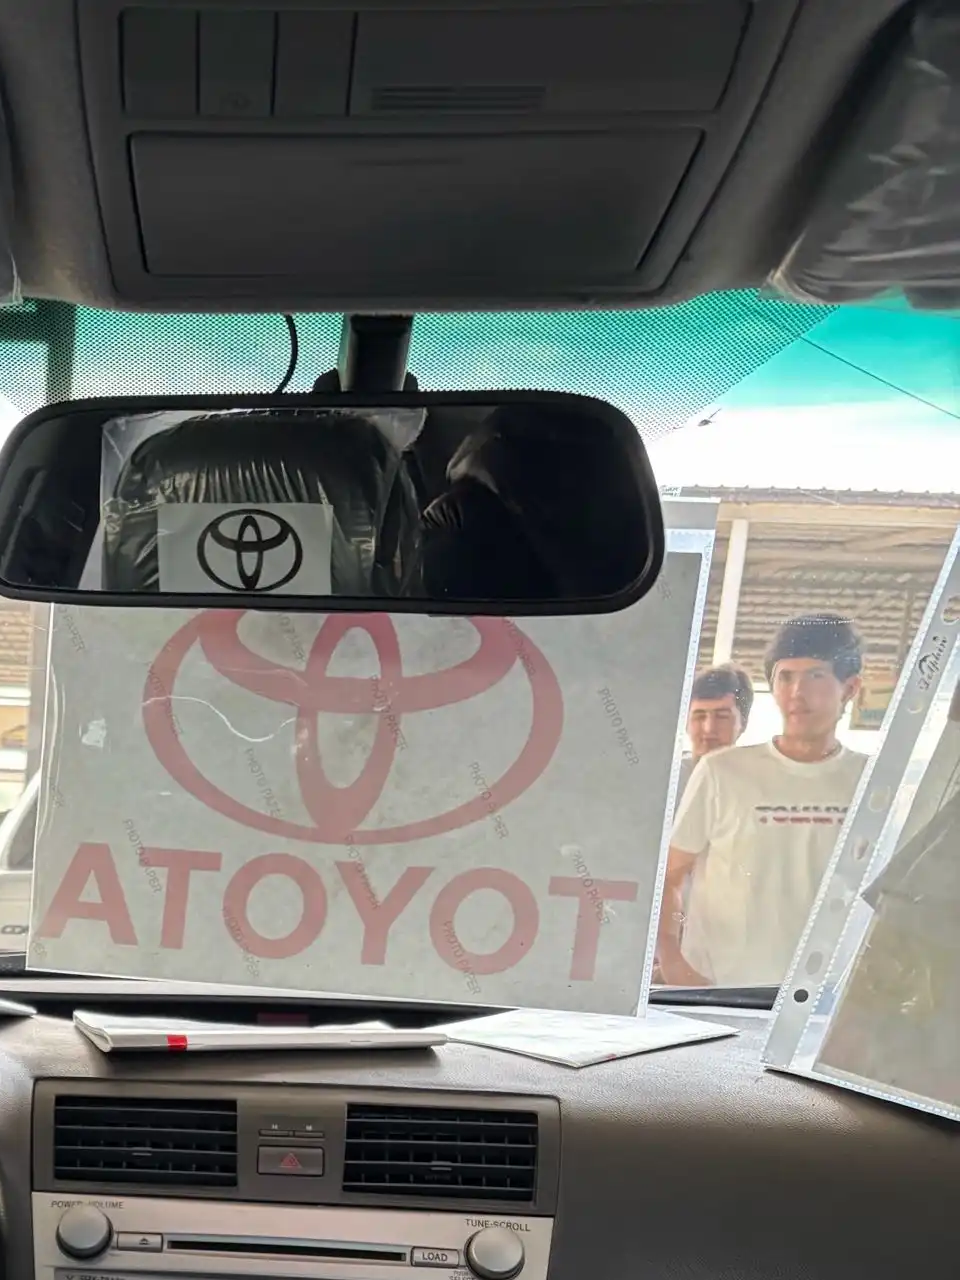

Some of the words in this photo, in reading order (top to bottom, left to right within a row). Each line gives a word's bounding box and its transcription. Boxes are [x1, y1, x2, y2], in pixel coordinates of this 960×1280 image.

[597, 687, 623, 727] PHOTO
[615, 727, 640, 766] PAPER
[469, 762, 492, 801] PHOTO
[122, 818, 145, 857] PHOTO
[571, 850, 594, 888] PHOTO
[586, 888, 611, 925] PAPER
[443, 919, 465, 958] PHOTO
[455, 957, 481, 995] PAPER
[422, 1251, 448, 1262] LOAD
